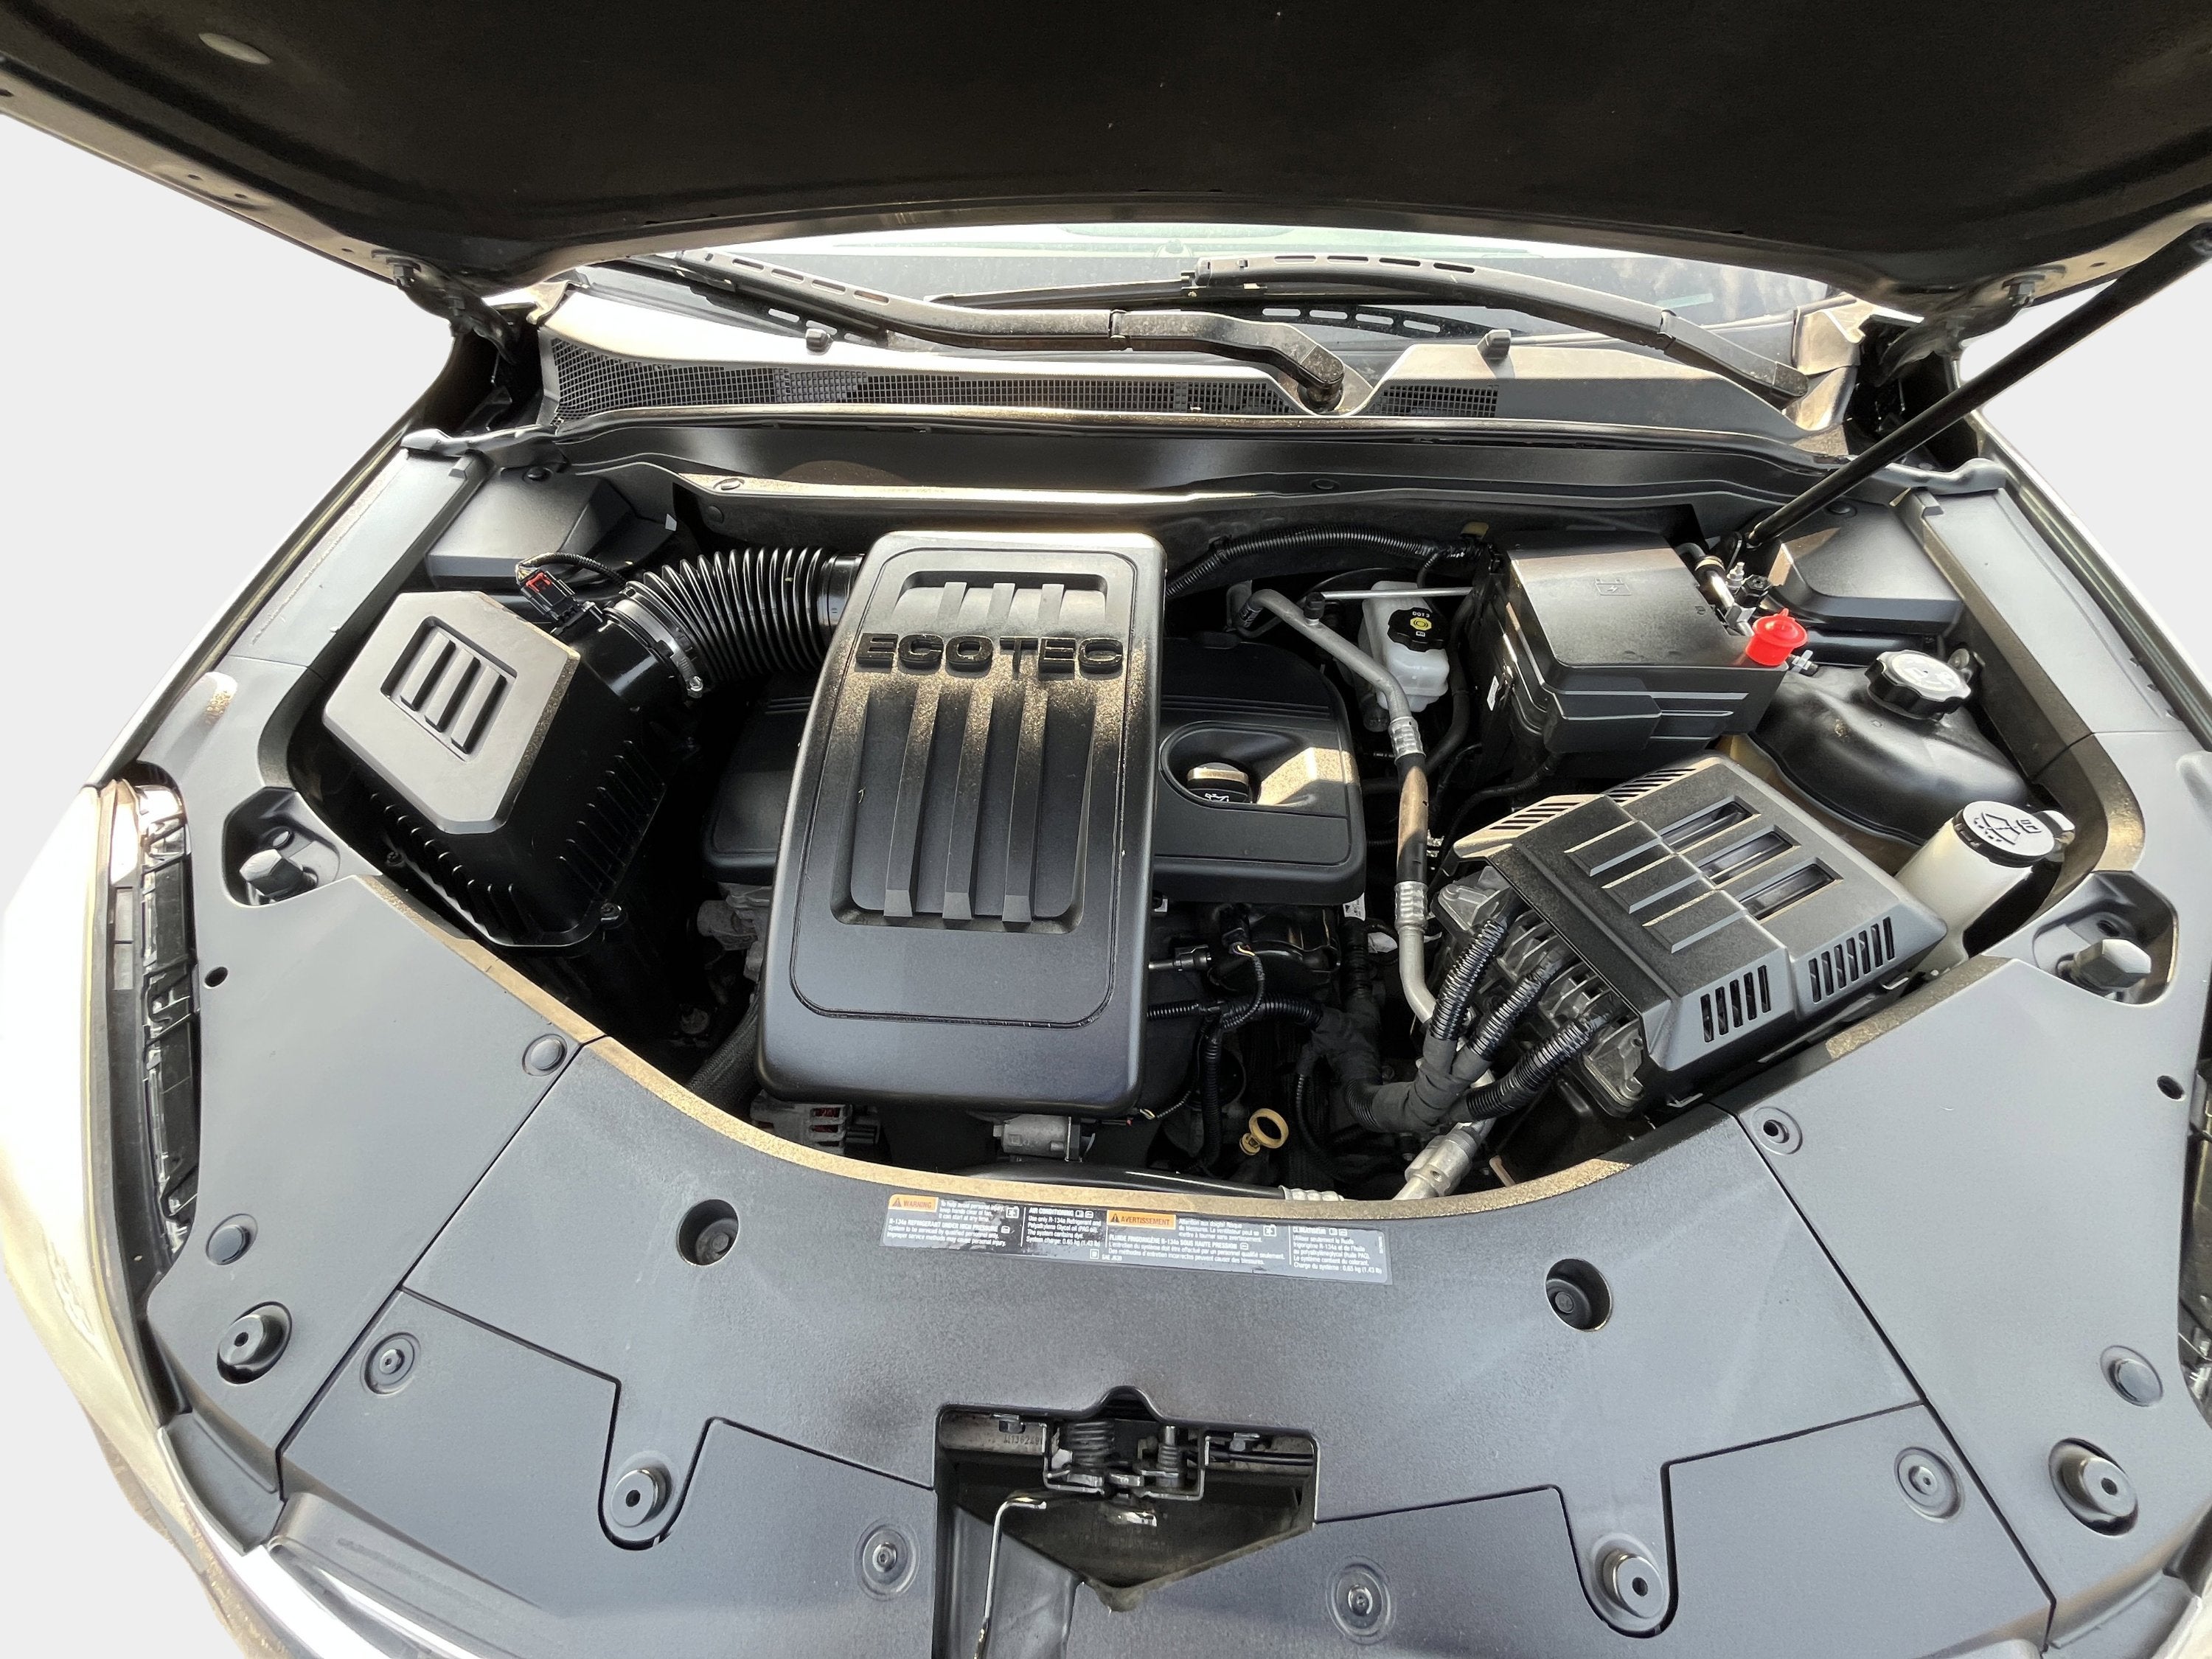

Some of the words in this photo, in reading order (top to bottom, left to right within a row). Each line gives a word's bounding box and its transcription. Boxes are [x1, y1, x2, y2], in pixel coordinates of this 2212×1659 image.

[855, 633, 1124, 678] ECOTEC
[904, 1200, 931, 1208] WARNING
[1121, 1216, 1170, 1226] AVERTISSEMENT
